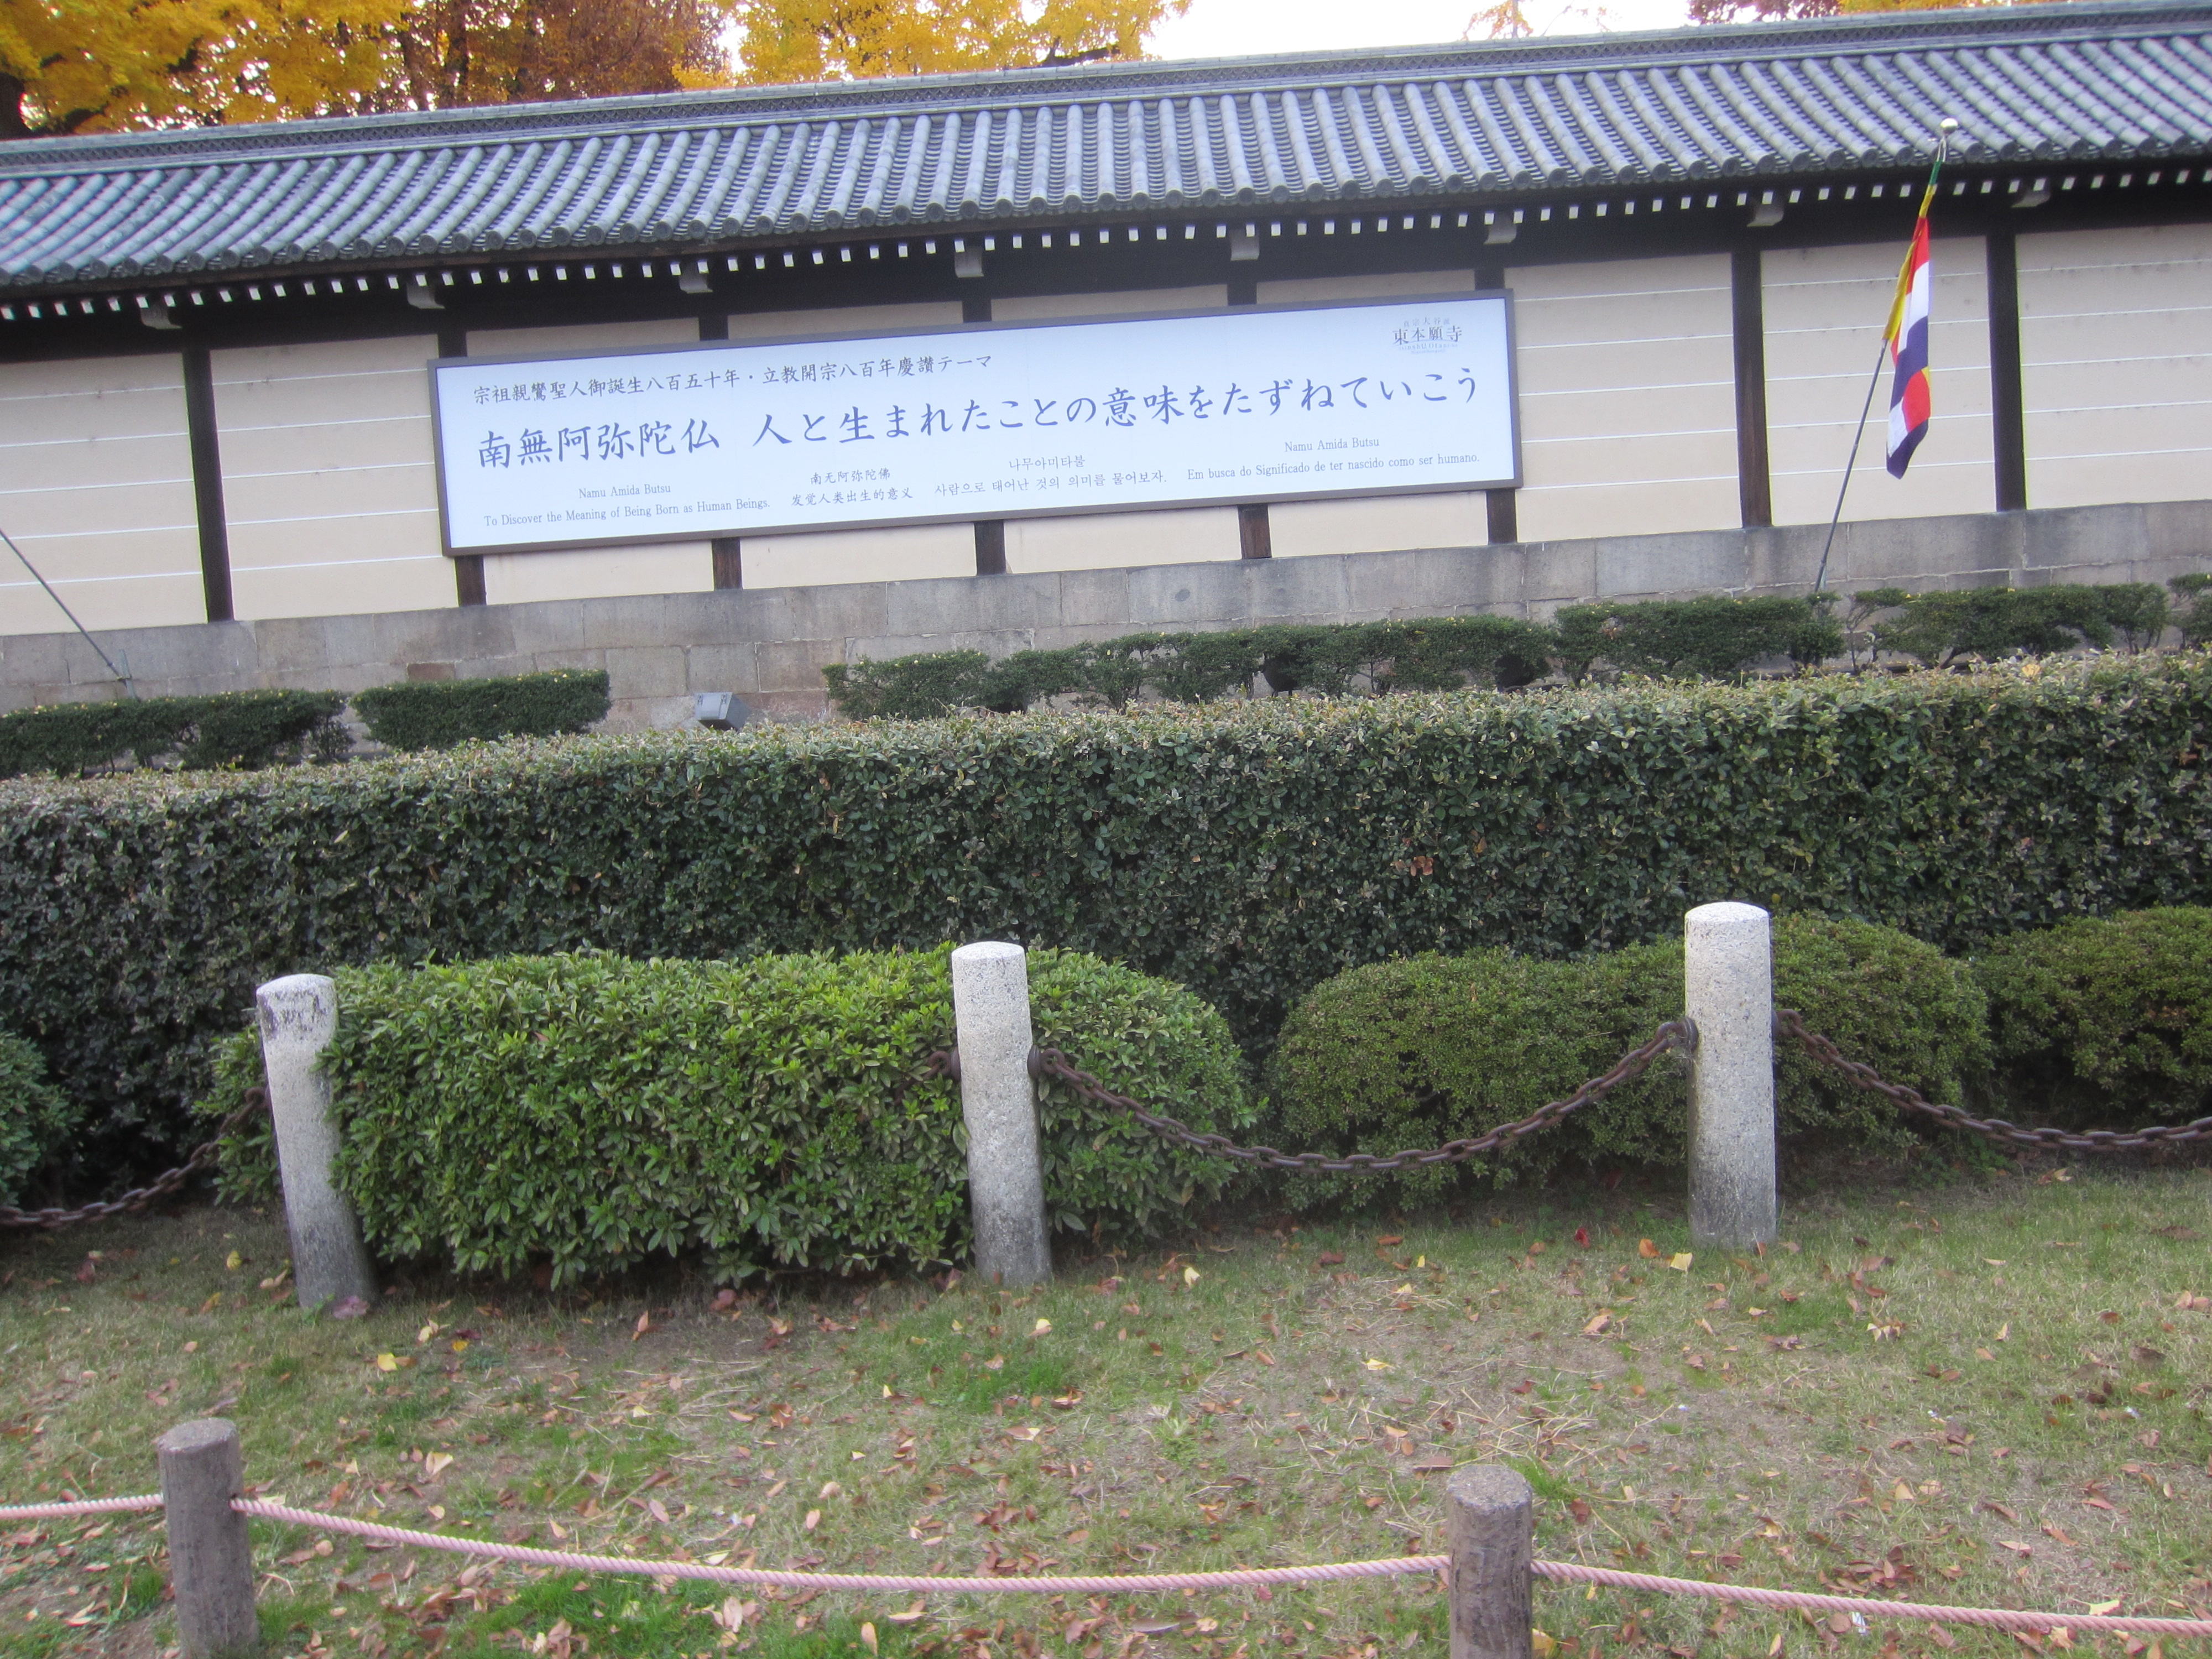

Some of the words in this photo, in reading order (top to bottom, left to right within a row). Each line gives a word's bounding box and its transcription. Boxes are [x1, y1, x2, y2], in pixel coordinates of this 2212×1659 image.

[1392, 325, 1462, 345] 東本願寺
[478, 418, 721, 469] 南無阿弥陀仏
[753, 368, 1475, 446] 人と生まれたことの意味をたずねていこう
[1285, 441, 1313, 452] Namu
[1317, 439, 1348, 450] Amida
[1352, 437, 1380, 448] Butsu
[1009, 455, 1086, 471] 나무아미타불
[1187, 469, 1204, 479] Em
[1208, 467, 1236, 478] busca
[1240, 466, 1252, 477] do
[1255, 462, 1310, 477] Significado
[1314, 461, 1326, 472] de
[1329, 461, 1344, 472] ter
[1348, 457, 1384, 470] nascido
[1388, 458, 1415, 467] como
[1418, 456, 1433, 465] ser
[1437, 452, 1480, 464] humano.
[810, 467, 890, 485] 南无阿弥陀佛
[935, 482, 986, 496] 사람으로
[992, 478, 1029, 492] 태어난
[1036, 476, 1060, 491] 것의
[1068, 473, 1105, 488] 의미를
[1112, 470, 1167, 486] 물어보자.
[578, 488, 606, 499] Namu
[610, 484, 640, 497] Amida
[644, 484, 671, 494] Butsu
[791, 487, 913, 507] 发觉人类出生的意义
[484, 515, 498, 526] To
[501, 513, 542, 525] Discover
[547, 511, 562, 523] the
[566, 509, 607, 521] Meaning
[611, 506, 620, 518] of
[624, 505, 652, 517] Being
[655, 504, 679, 516] Born
[683, 504, 693, 513] as
[697, 500, 732, 513] Human
[736, 498, 771, 510] Beings.
